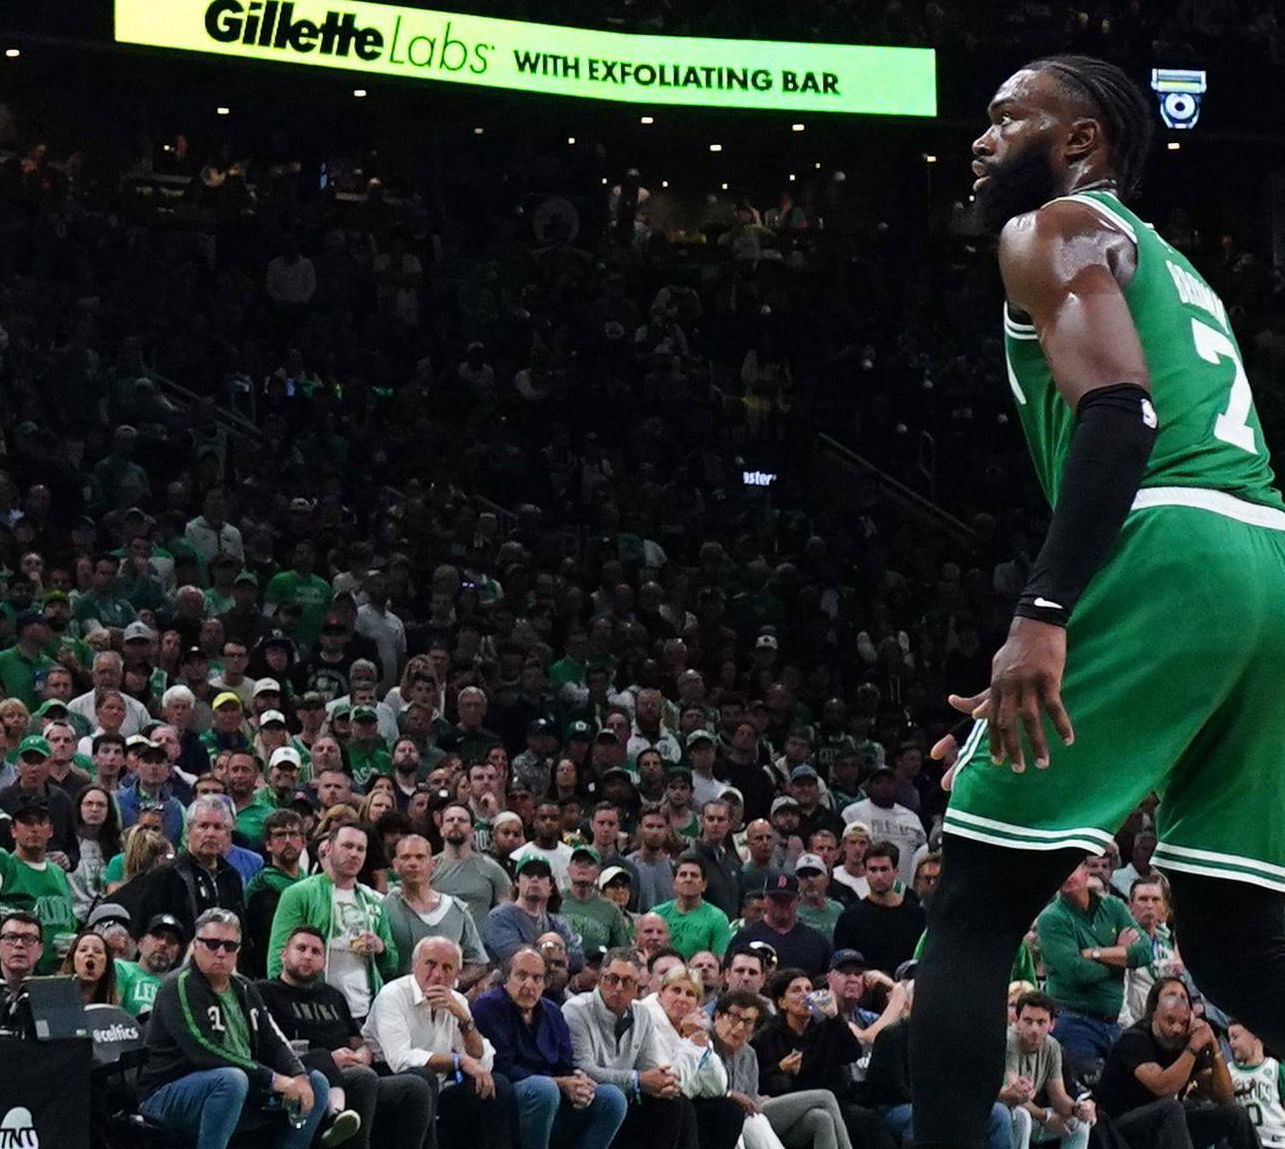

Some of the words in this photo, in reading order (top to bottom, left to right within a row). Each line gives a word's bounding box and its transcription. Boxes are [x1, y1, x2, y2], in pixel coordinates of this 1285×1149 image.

[513, 50, 580, 79] WITH
[588, 58, 773, 92] EXFOLIATING
[782, 69, 841, 96] BAR
[1191, 317, 1260, 455] 7
